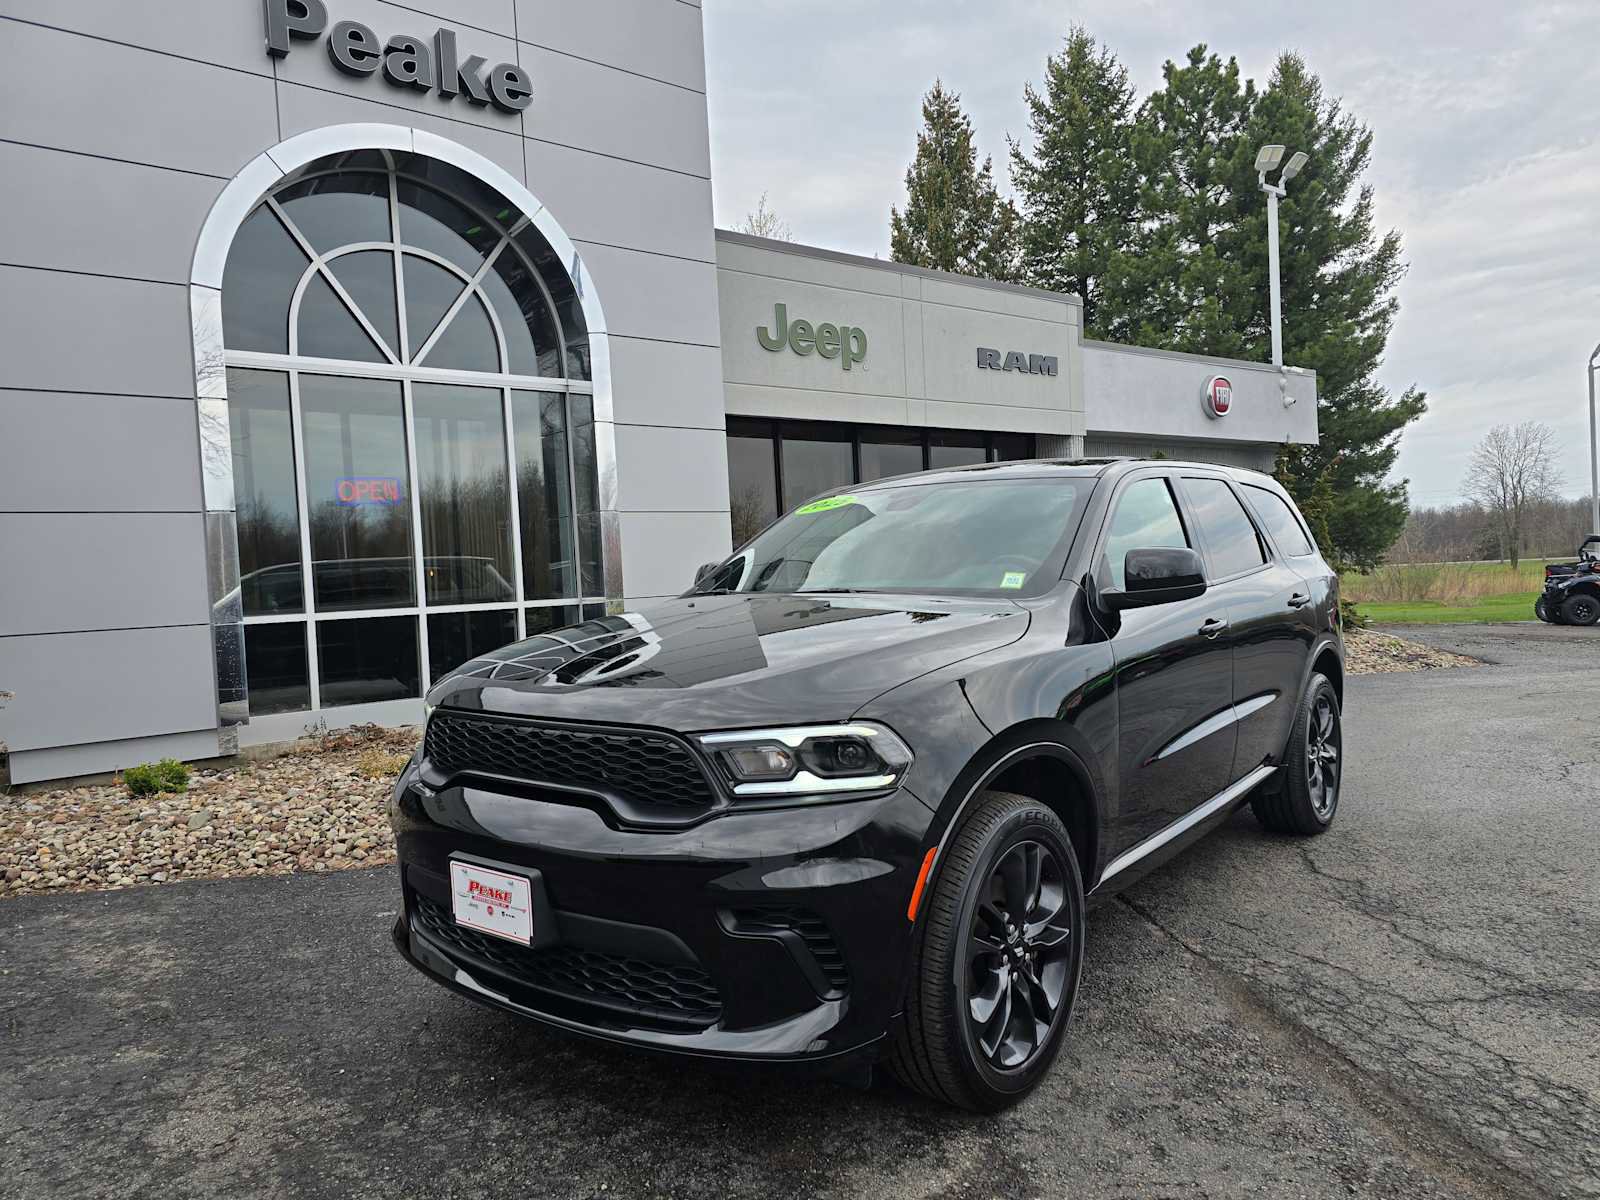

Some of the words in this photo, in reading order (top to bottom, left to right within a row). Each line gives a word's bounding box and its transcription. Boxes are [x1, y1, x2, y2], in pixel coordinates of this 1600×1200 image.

[264, 0, 534, 114] Peake
[757, 303, 868, 371] Jeep
[976, 347, 1059, 377] RAM
[338, 479, 399, 502] OPEN
[468, 880, 512, 904] PEAKE
